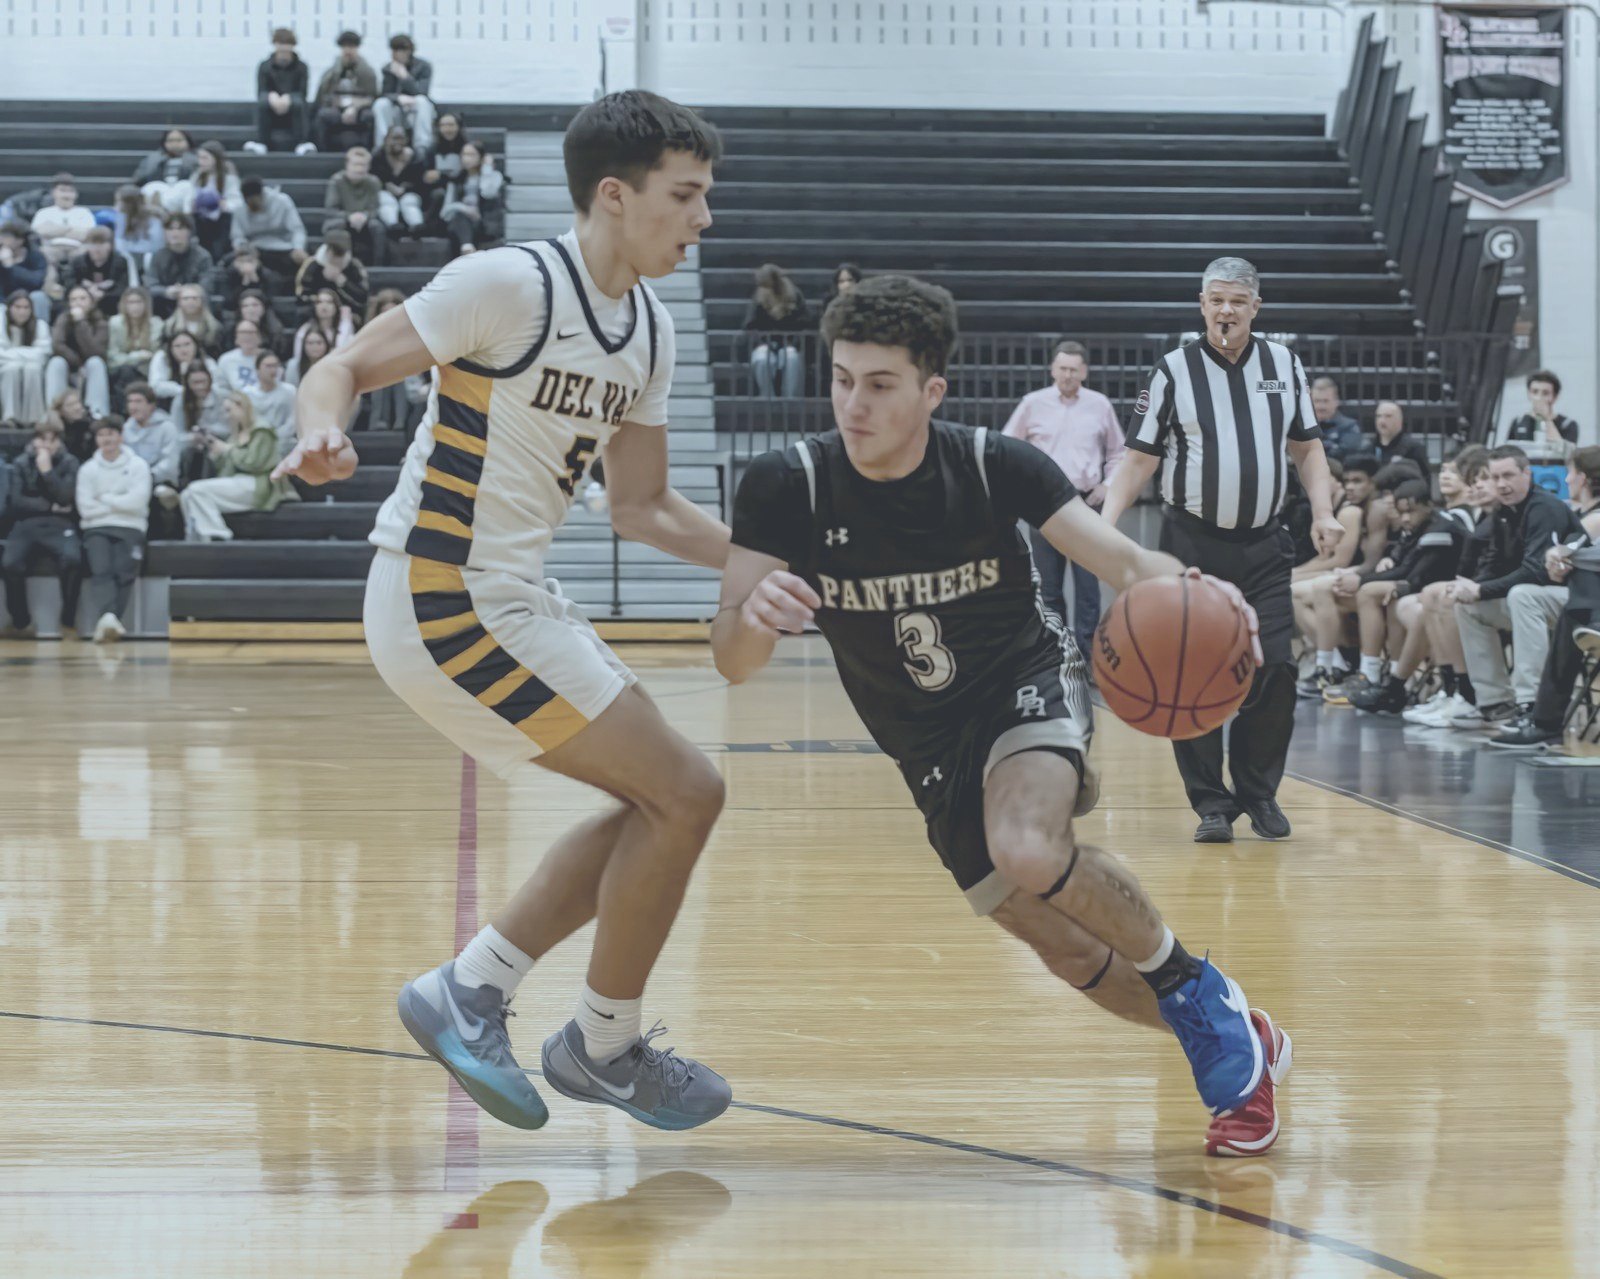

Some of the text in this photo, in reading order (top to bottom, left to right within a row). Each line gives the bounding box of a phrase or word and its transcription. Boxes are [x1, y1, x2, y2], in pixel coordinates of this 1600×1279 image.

[530, 367, 595, 420] DEL
[557, 433, 598, 497] 5
[816, 557, 1000, 611] PANTHERS
[894, 611, 957, 692] 3
